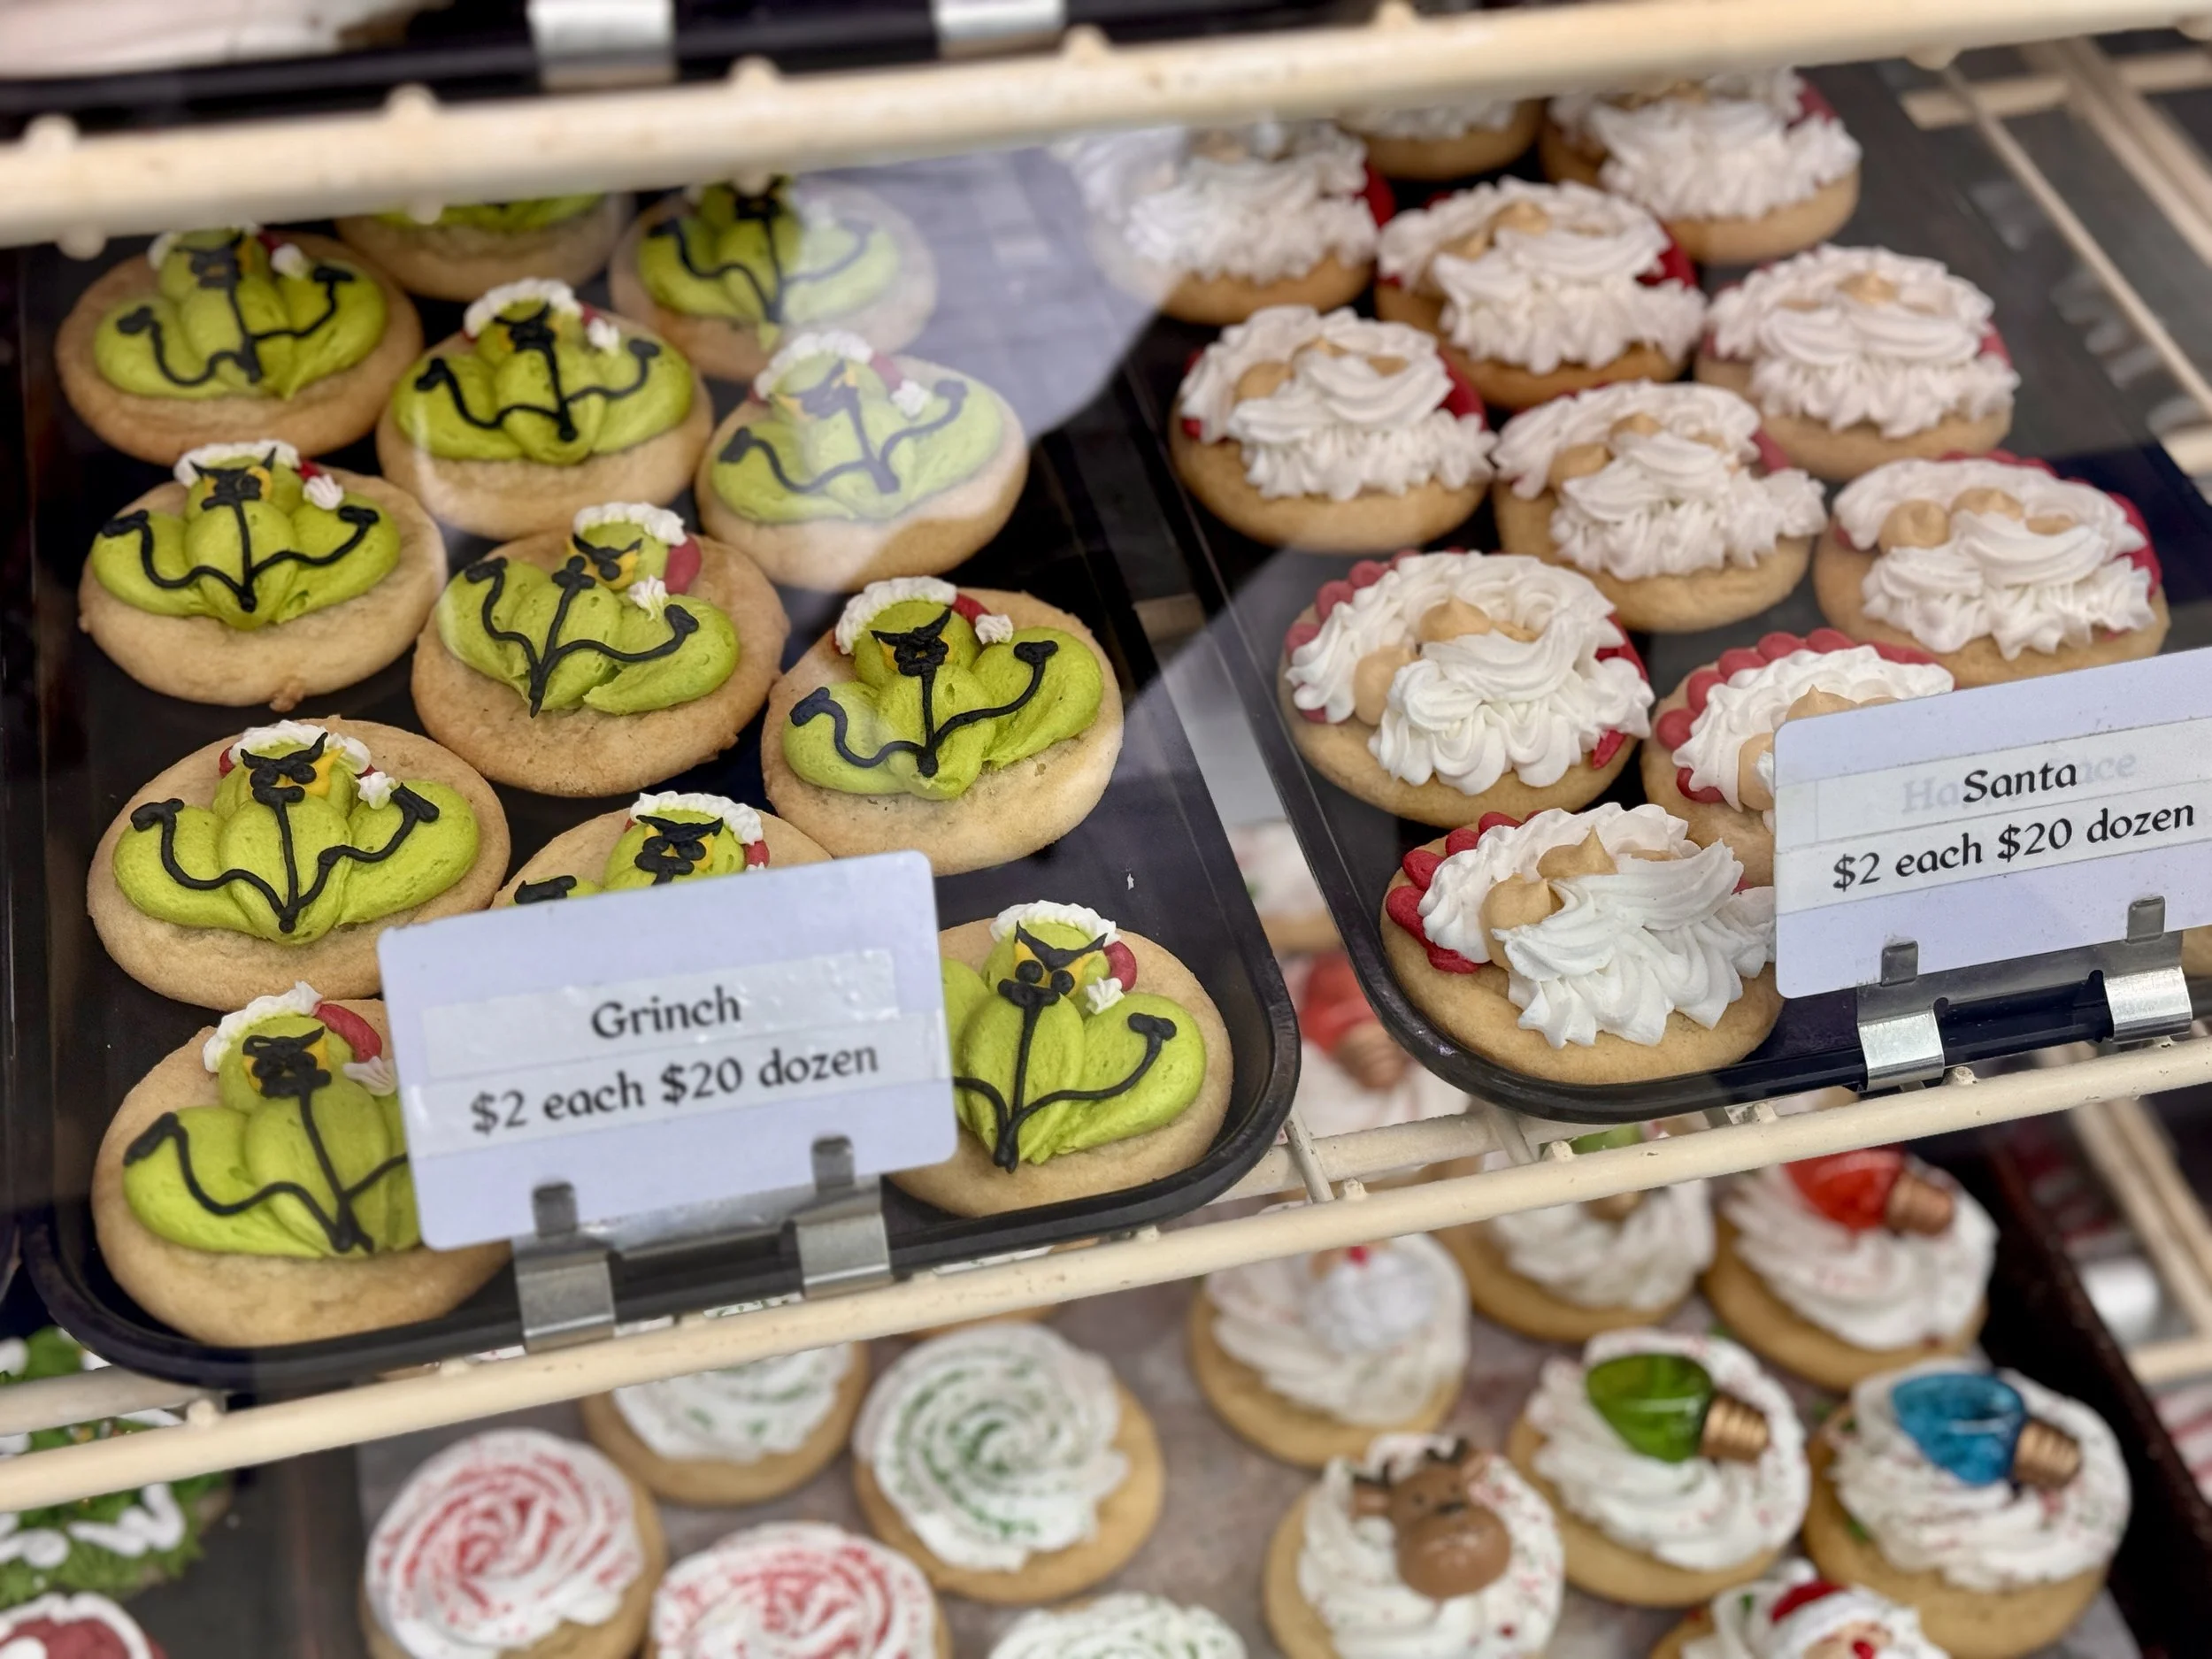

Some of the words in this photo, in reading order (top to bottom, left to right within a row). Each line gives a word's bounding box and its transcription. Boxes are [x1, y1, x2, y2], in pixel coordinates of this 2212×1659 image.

[1962, 762, 2078, 803] Santa
[1832, 851, 1881, 892] $2
[1895, 832, 1983, 878] each
[1997, 818, 2073, 864] $20
[2086, 804, 2194, 844] dozen
[591, 986, 741, 1040] Grinch
[470, 1089, 526, 1135] $2
[542, 1071, 644, 1121] each
[660, 1056, 743, 1106] $20
[758, 1046, 879, 1089] dozen
